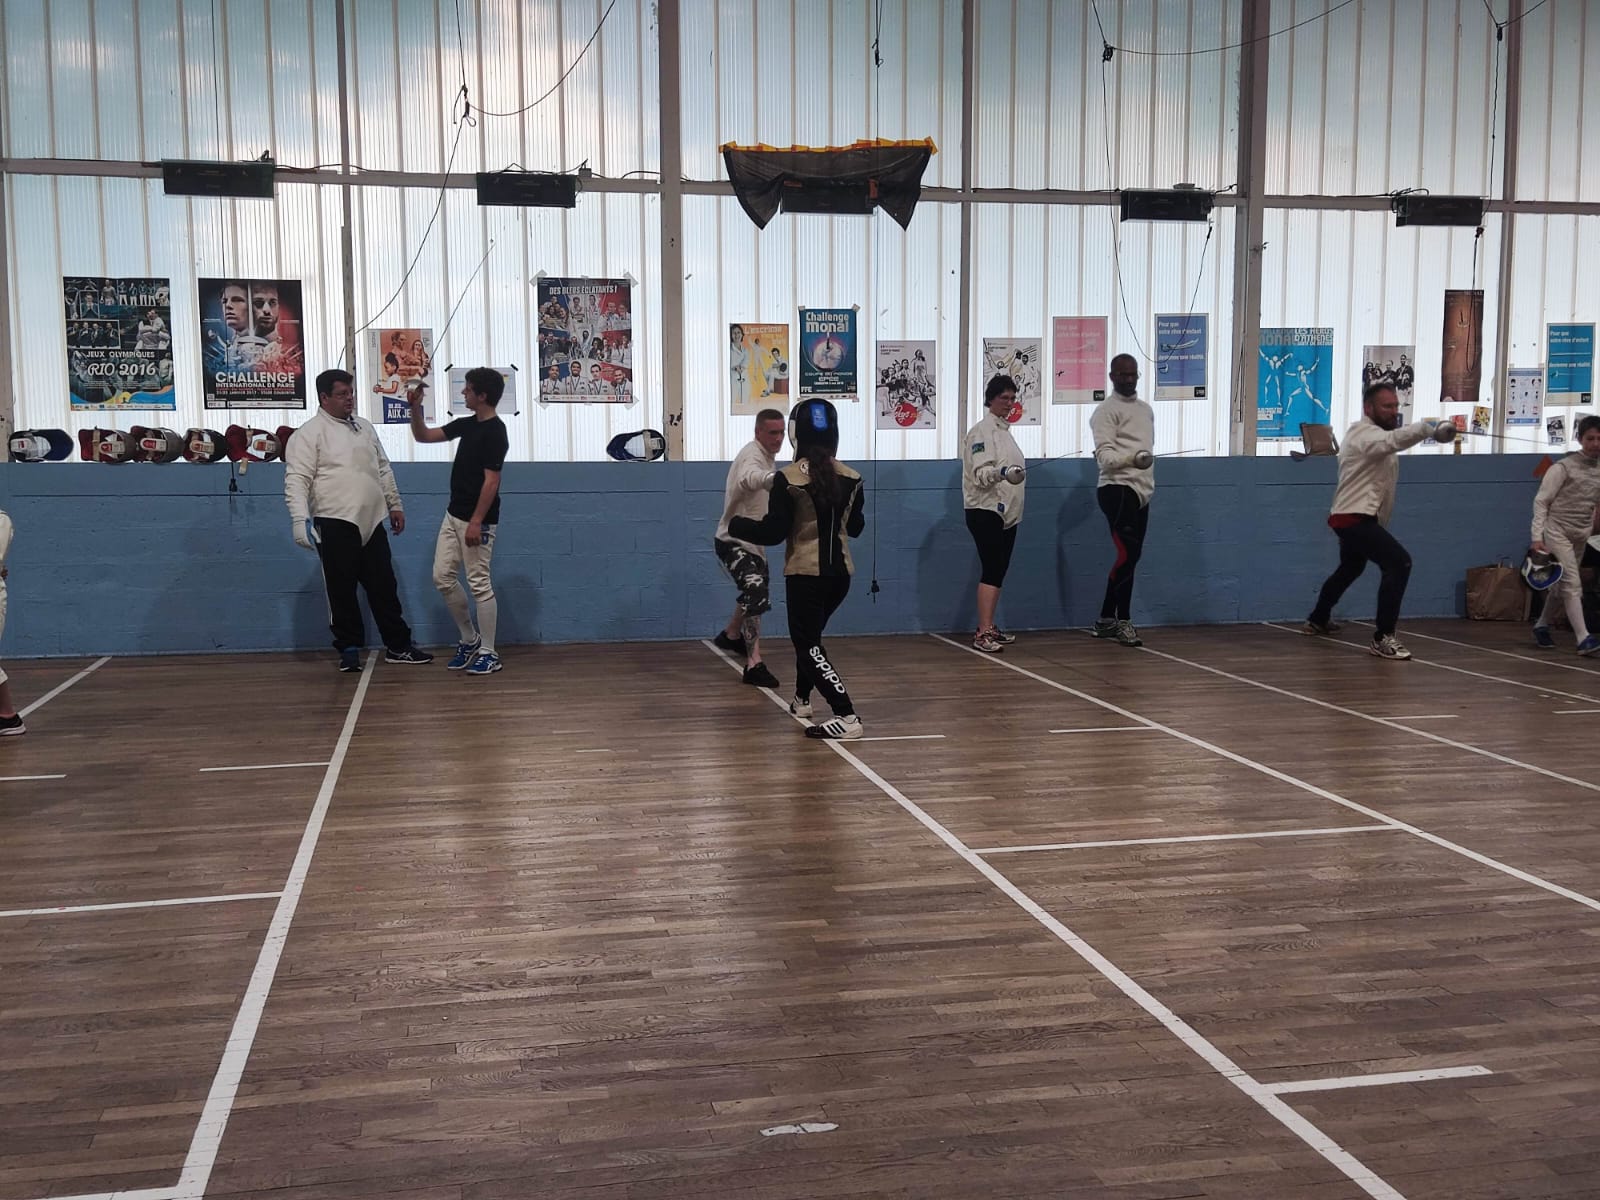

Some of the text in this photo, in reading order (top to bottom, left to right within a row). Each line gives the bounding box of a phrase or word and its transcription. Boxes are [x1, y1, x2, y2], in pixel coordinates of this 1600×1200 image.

[549, 287, 561, 295] DES
[86, 350, 155, 358] JEUX OLYMPIQUES
[87, 362, 156, 376] RIO 2016
[215, 372, 295, 383] CHALLENGE
[387, 409, 401, 419] AUX
[809, 646, 846, 694] adidas
